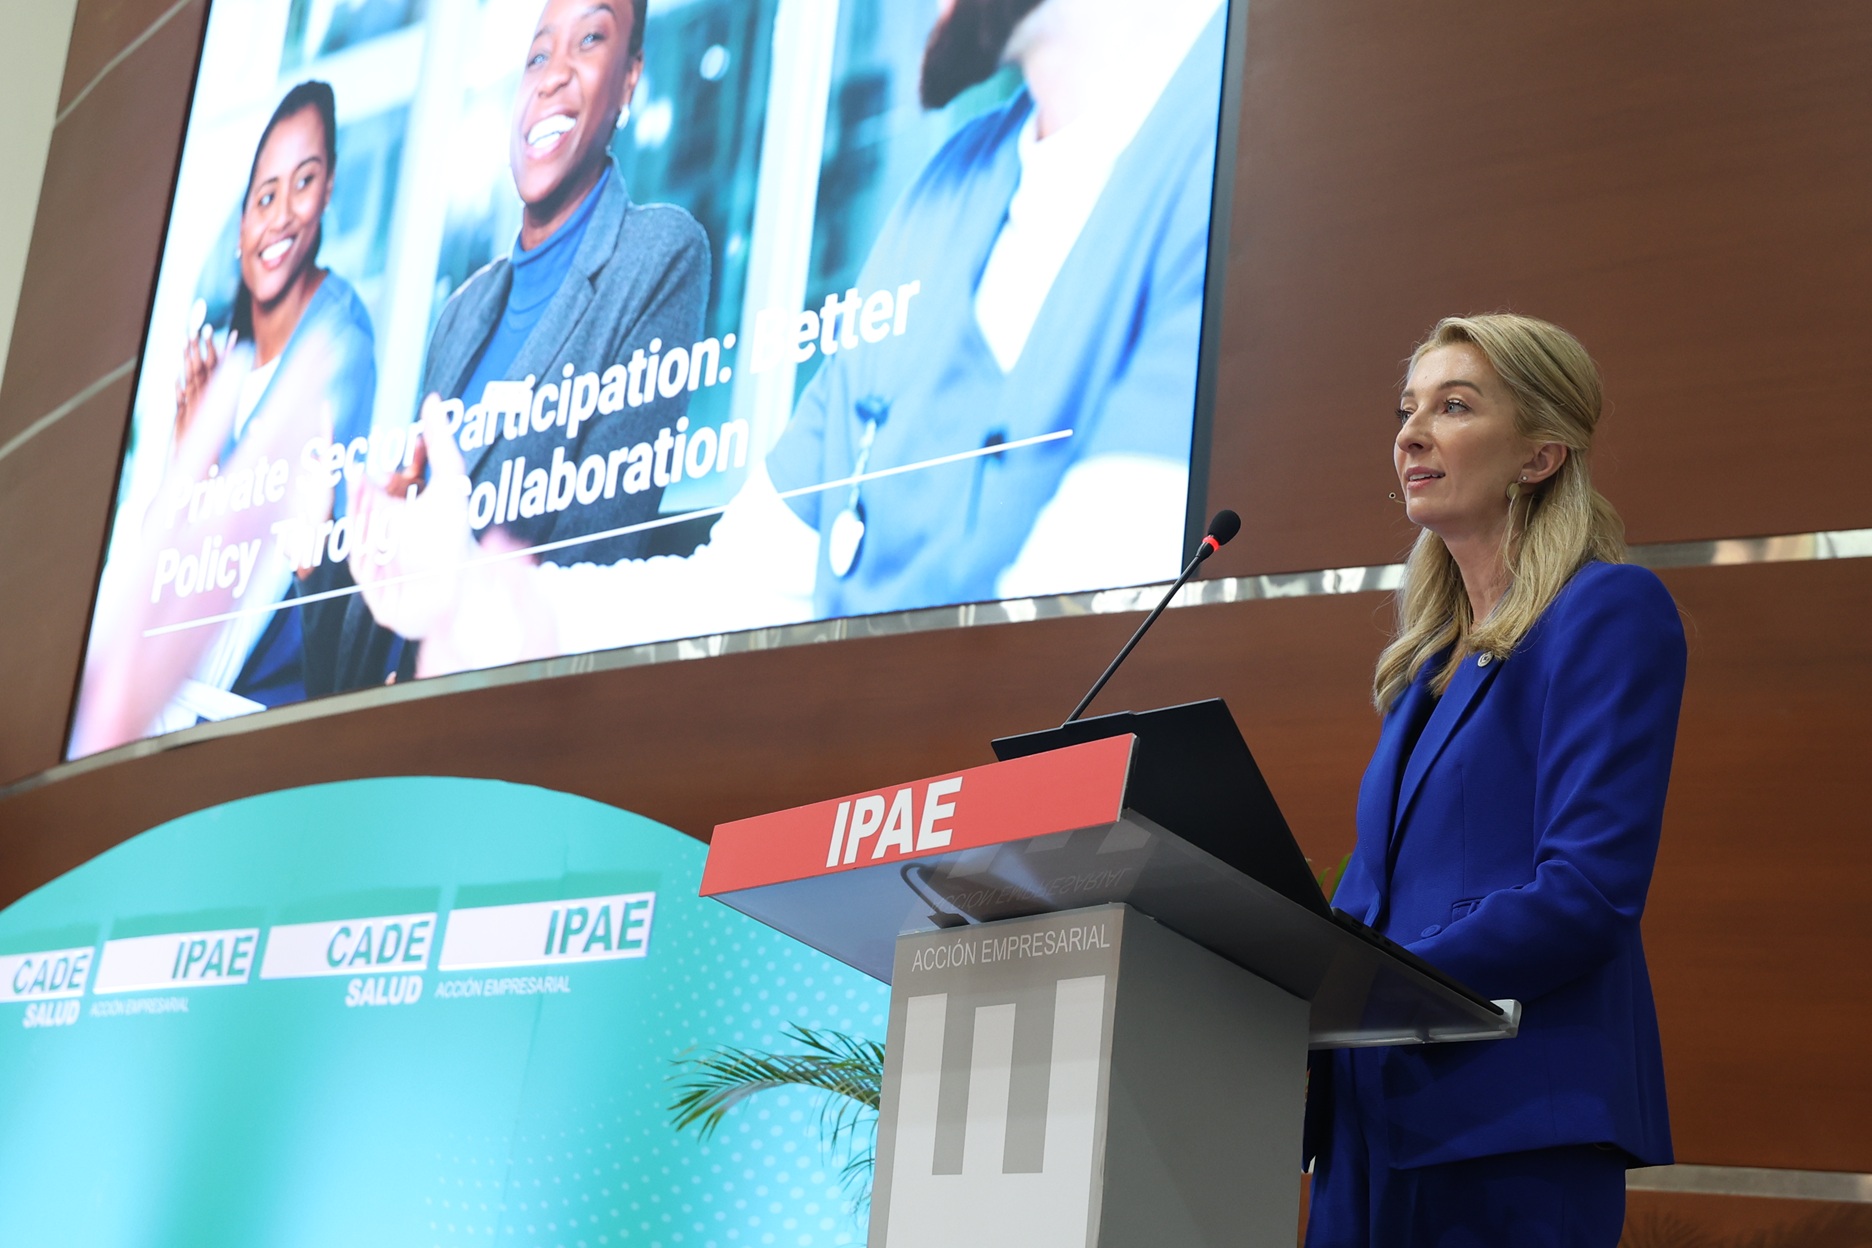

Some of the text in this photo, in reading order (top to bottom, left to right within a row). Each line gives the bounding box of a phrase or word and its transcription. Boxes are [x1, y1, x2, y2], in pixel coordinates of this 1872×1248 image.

[164, 280, 921, 530] Private Sector Participation: Better
[151, 416, 749, 604] Policy Throug ollaboration
[825, 776, 963, 868] IPAE
[326, 920, 430, 968] CADE
[544, 900, 651, 956] IPAE
[911, 924, 1110, 972] ACCIÓN EMPRESARIAL
[12, 954, 88, 994] CADE
[171, 935, 254, 980] IPAE
[345, 975, 423, 1007] SALUD
[434, 975, 571, 998] ACCIÓN EMPRESARIAL
[22, 999, 81, 1028] SALUD
